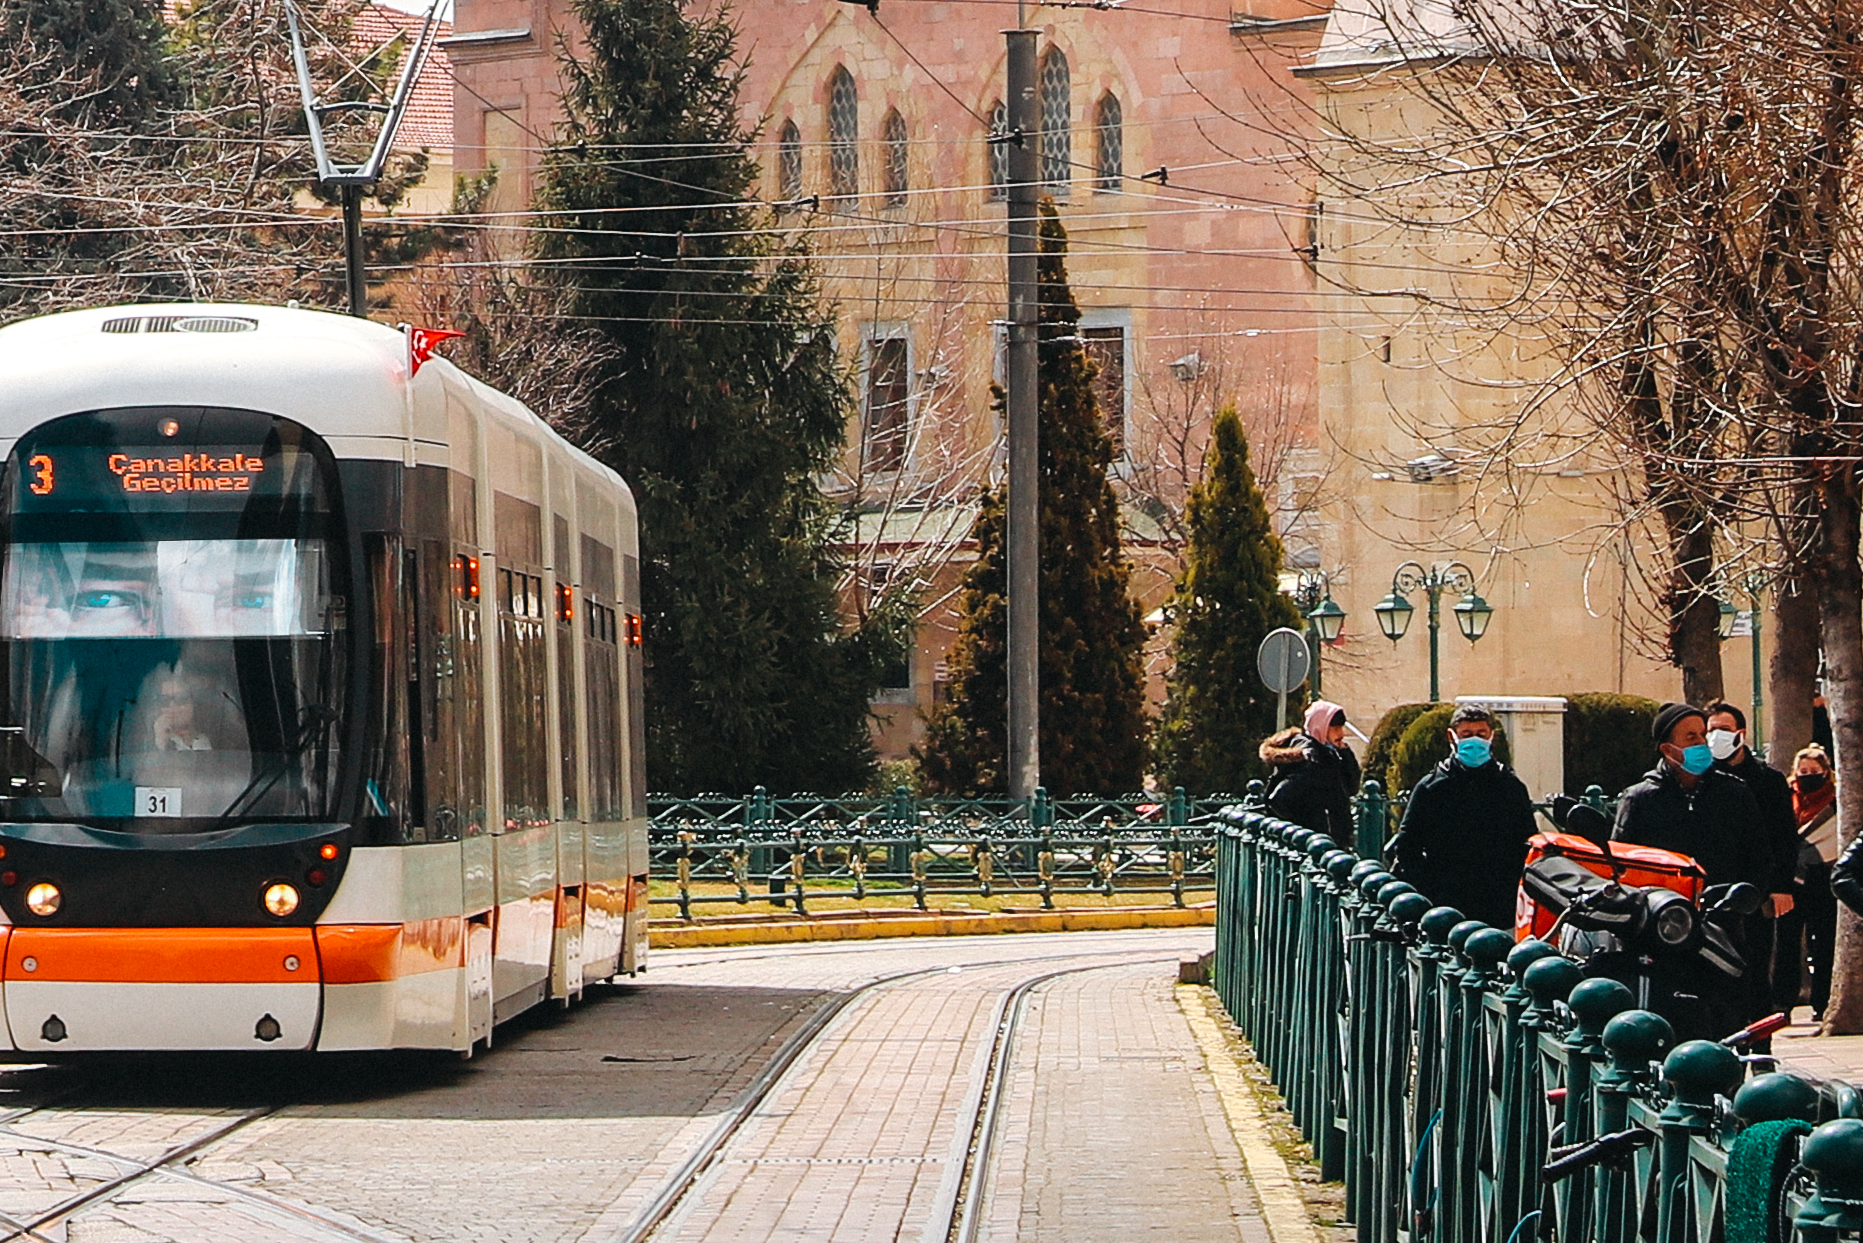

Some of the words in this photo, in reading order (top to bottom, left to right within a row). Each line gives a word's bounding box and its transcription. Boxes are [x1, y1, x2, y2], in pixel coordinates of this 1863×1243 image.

[29, 454, 53, 494] 3
[108, 453, 264, 475] Çanakkale
[122, 473, 250, 493] Geçilmez
[148, 795, 166, 814] 31
